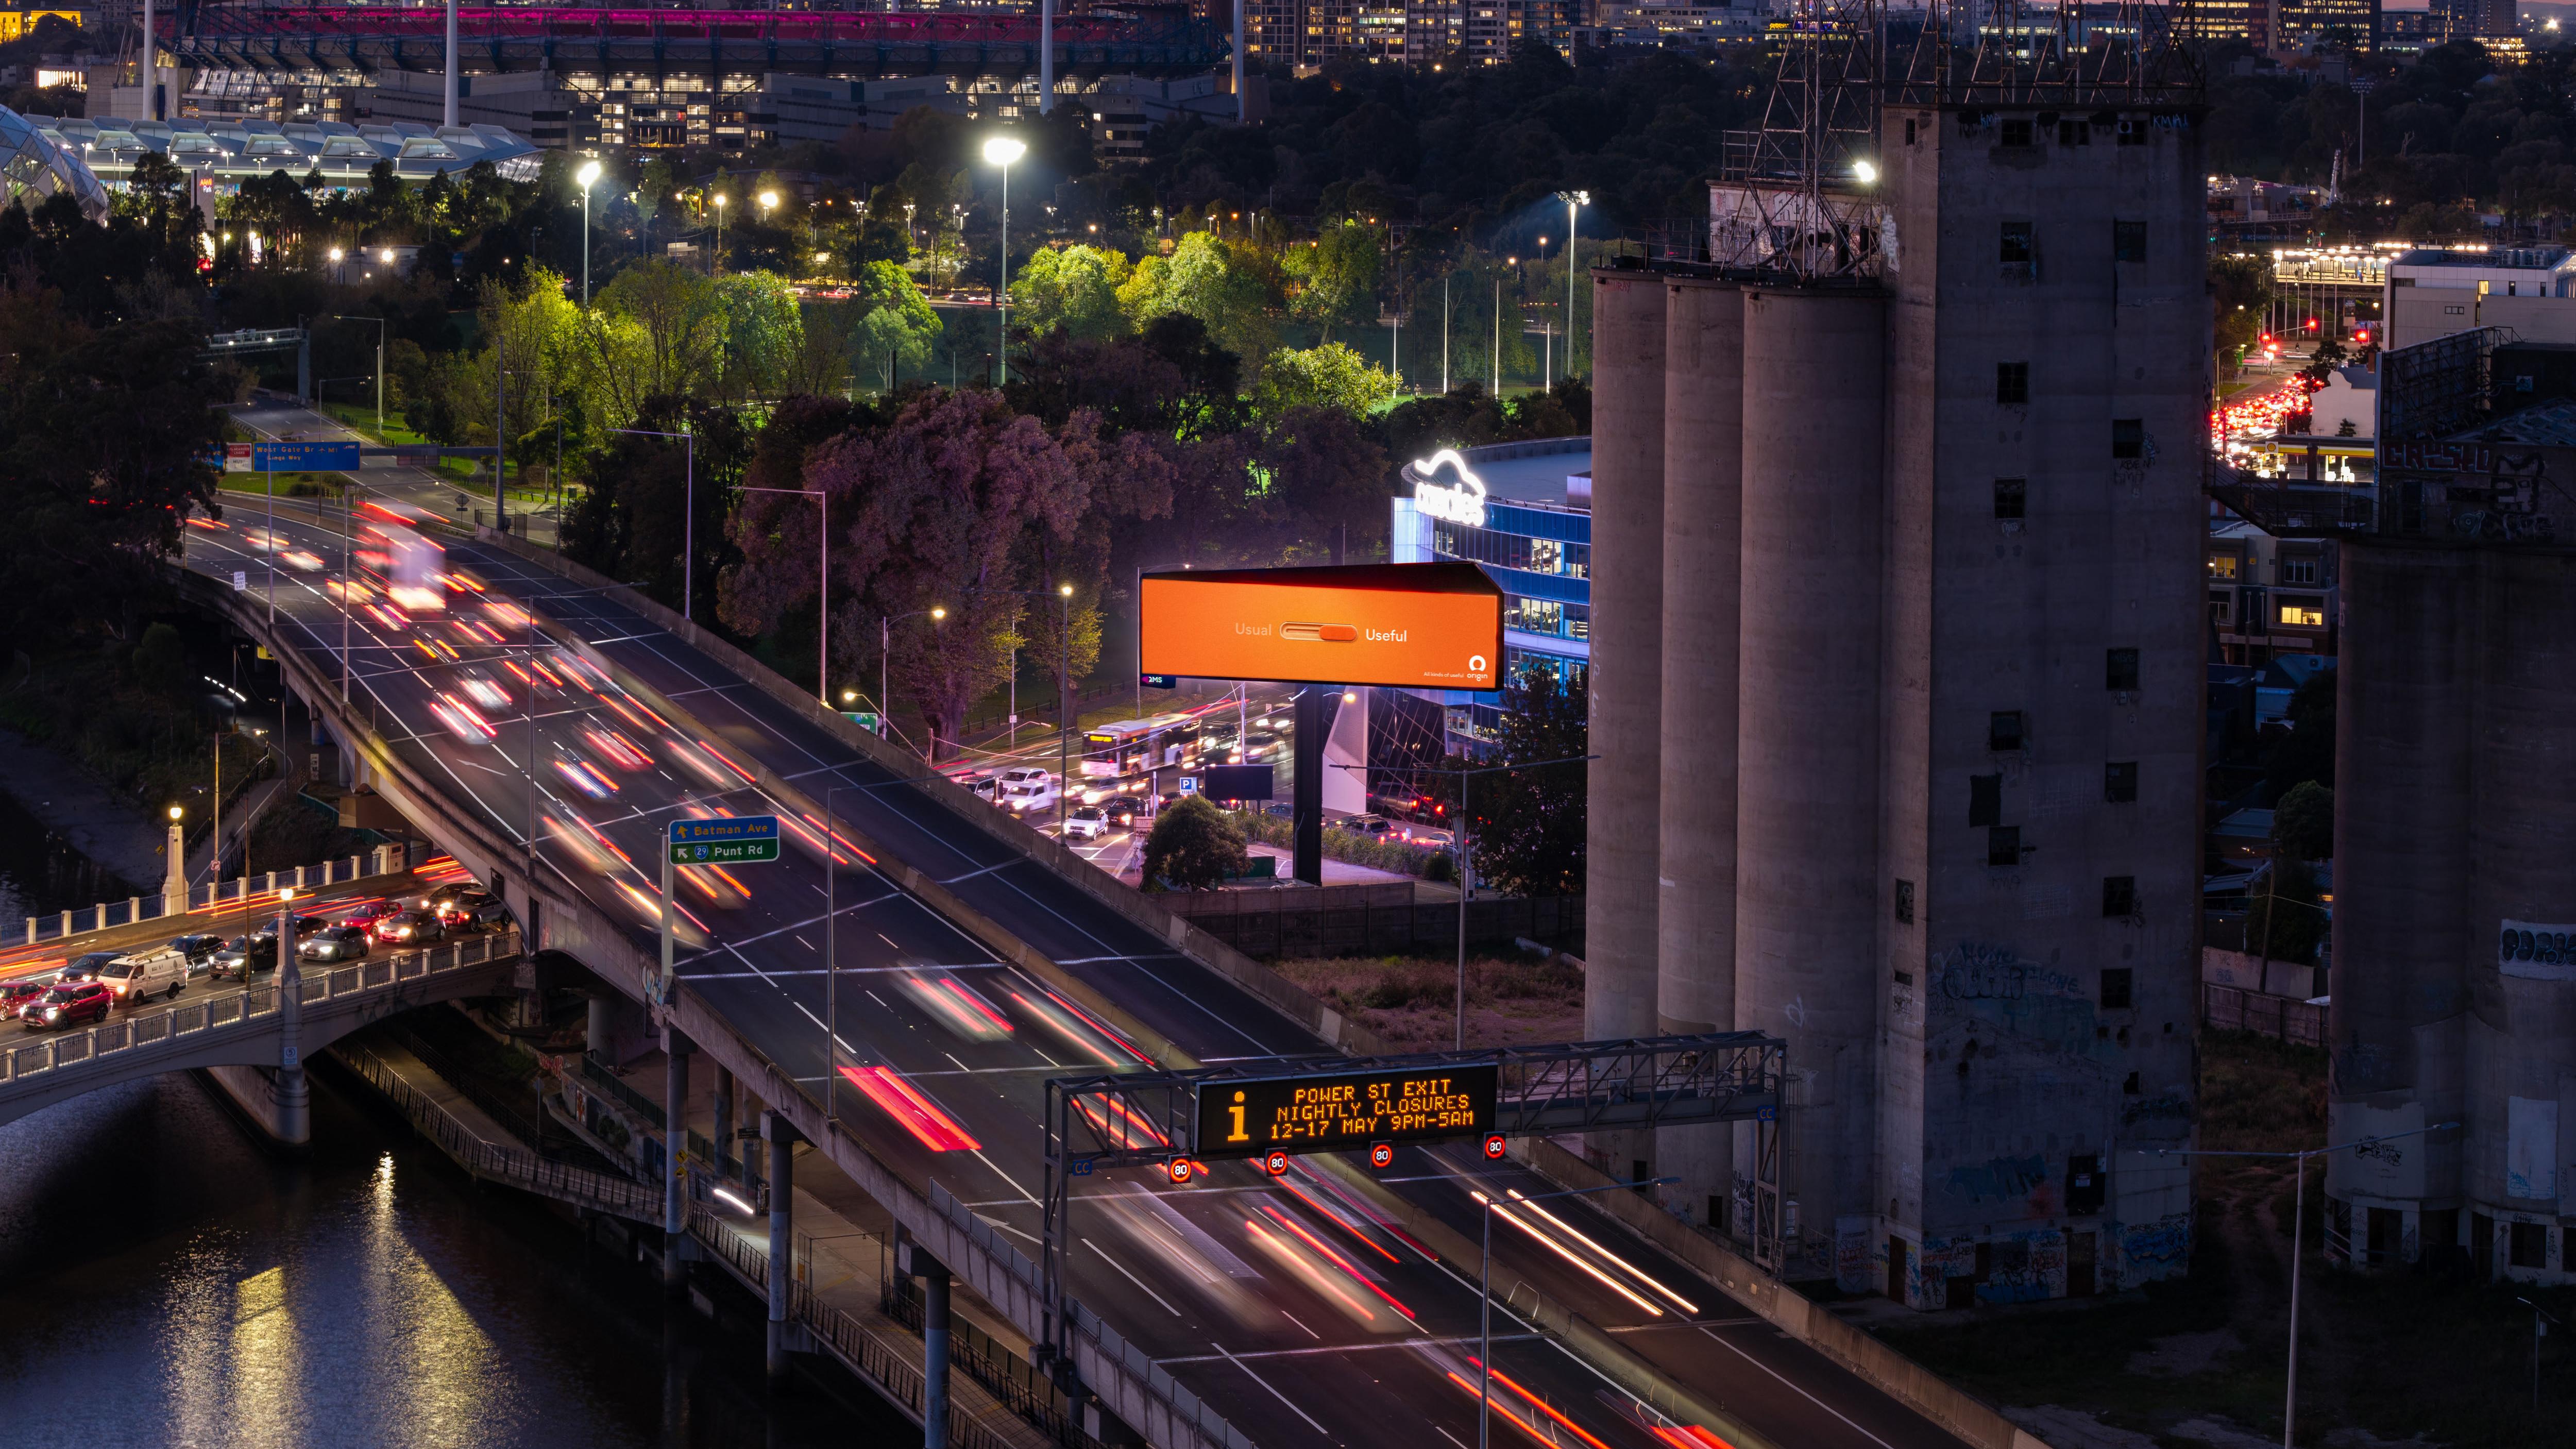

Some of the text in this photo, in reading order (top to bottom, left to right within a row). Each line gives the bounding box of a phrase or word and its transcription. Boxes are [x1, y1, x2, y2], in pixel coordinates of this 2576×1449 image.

[1235, 622, 1407, 642] Usual Useful
[1467, 673, 1488, 682] origin
[1183, 780, 1189, 788] P
[694, 824, 768, 836] Batman Ave
[715, 846, 742, 856] Punt
[748, 845, 762, 854] Rd
[1295, 1079, 1451, 1104] POWER ST EXIT
[1277, 1094, 1470, 1122] NIGHTLY CLOSURES
[1759, 1108, 1773, 1119] CC
[1270, 1110, 1475, 1140] 12-17 MAY 9PM-5AM
[1489, 1142, 1502, 1152] 80
[1376, 1151, 1388, 1160] 80
[1075, 1162, 1089, 1173] CC
[1271, 1158, 1283, 1168] 80
[1175, 1165, 1187, 1175] 80
